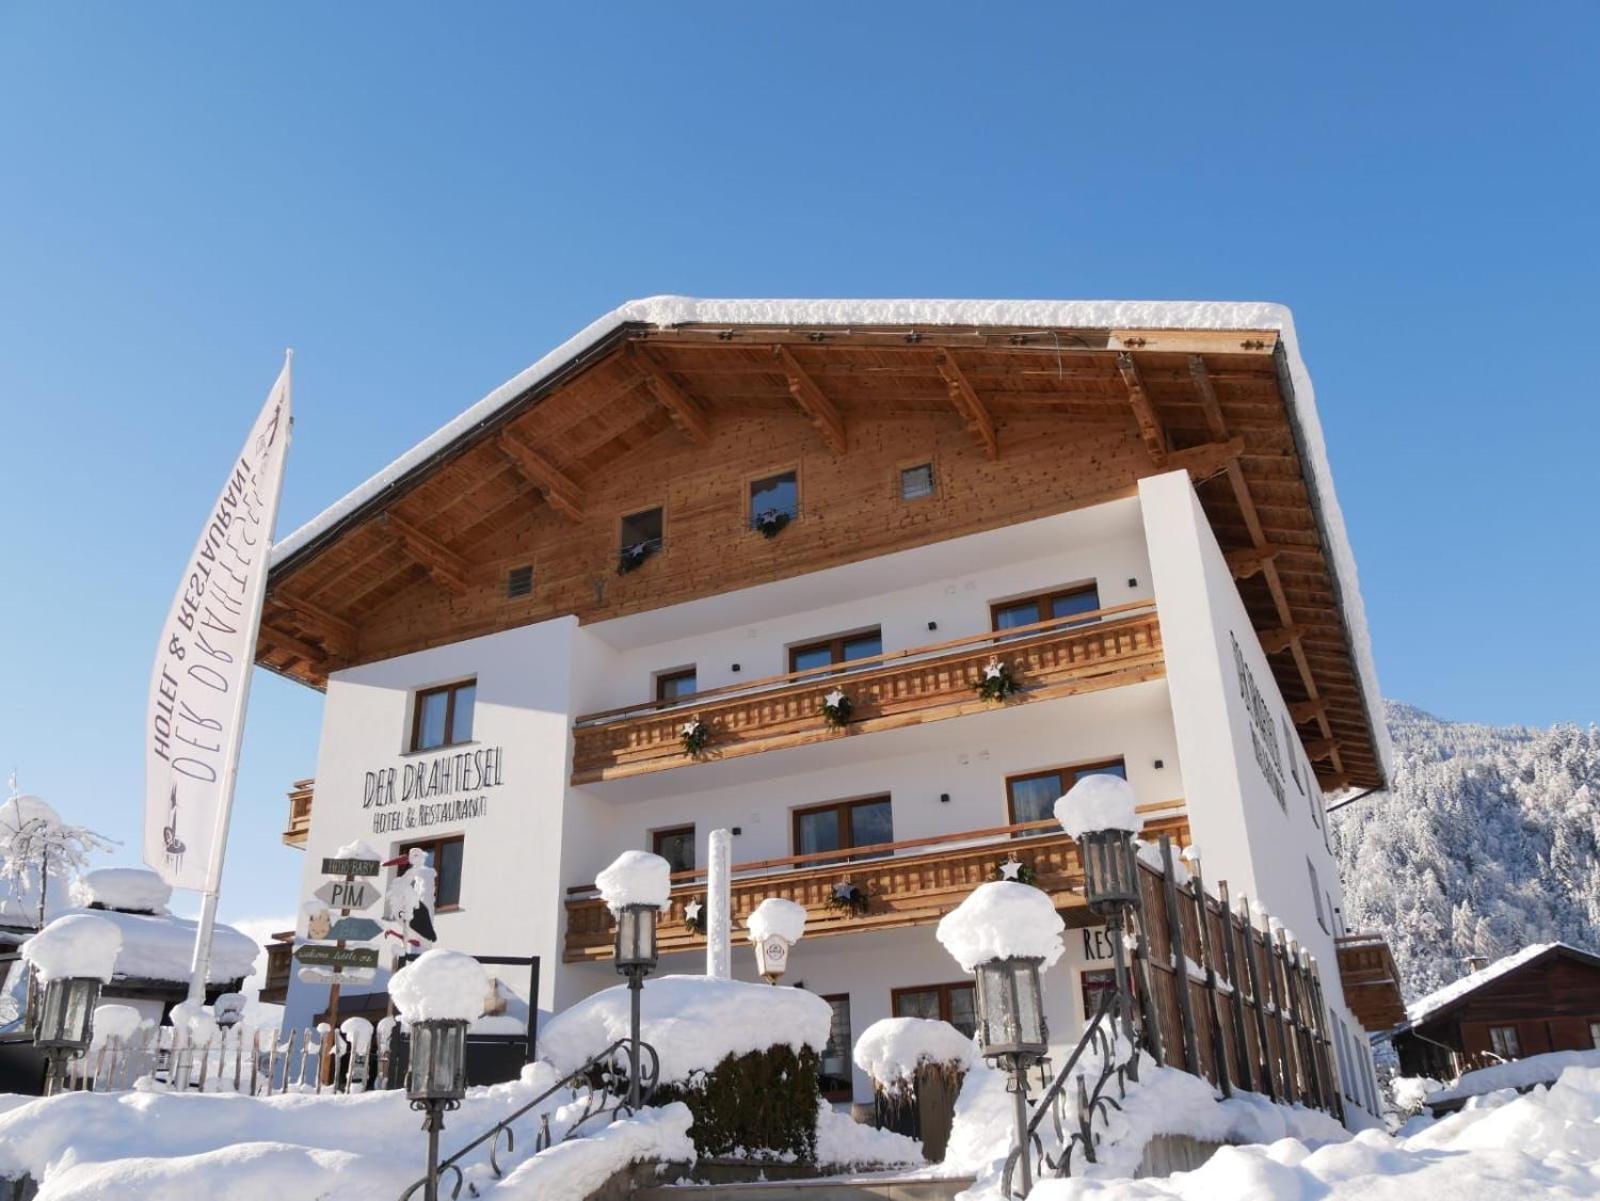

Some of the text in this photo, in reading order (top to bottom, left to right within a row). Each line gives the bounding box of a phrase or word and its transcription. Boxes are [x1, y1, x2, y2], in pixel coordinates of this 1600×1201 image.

[363, 746, 504, 808] DER DRAHTESEL
[373, 796, 487, 833] HOTEL & RESTAURANT
[331, 884, 365, 906] PIM
